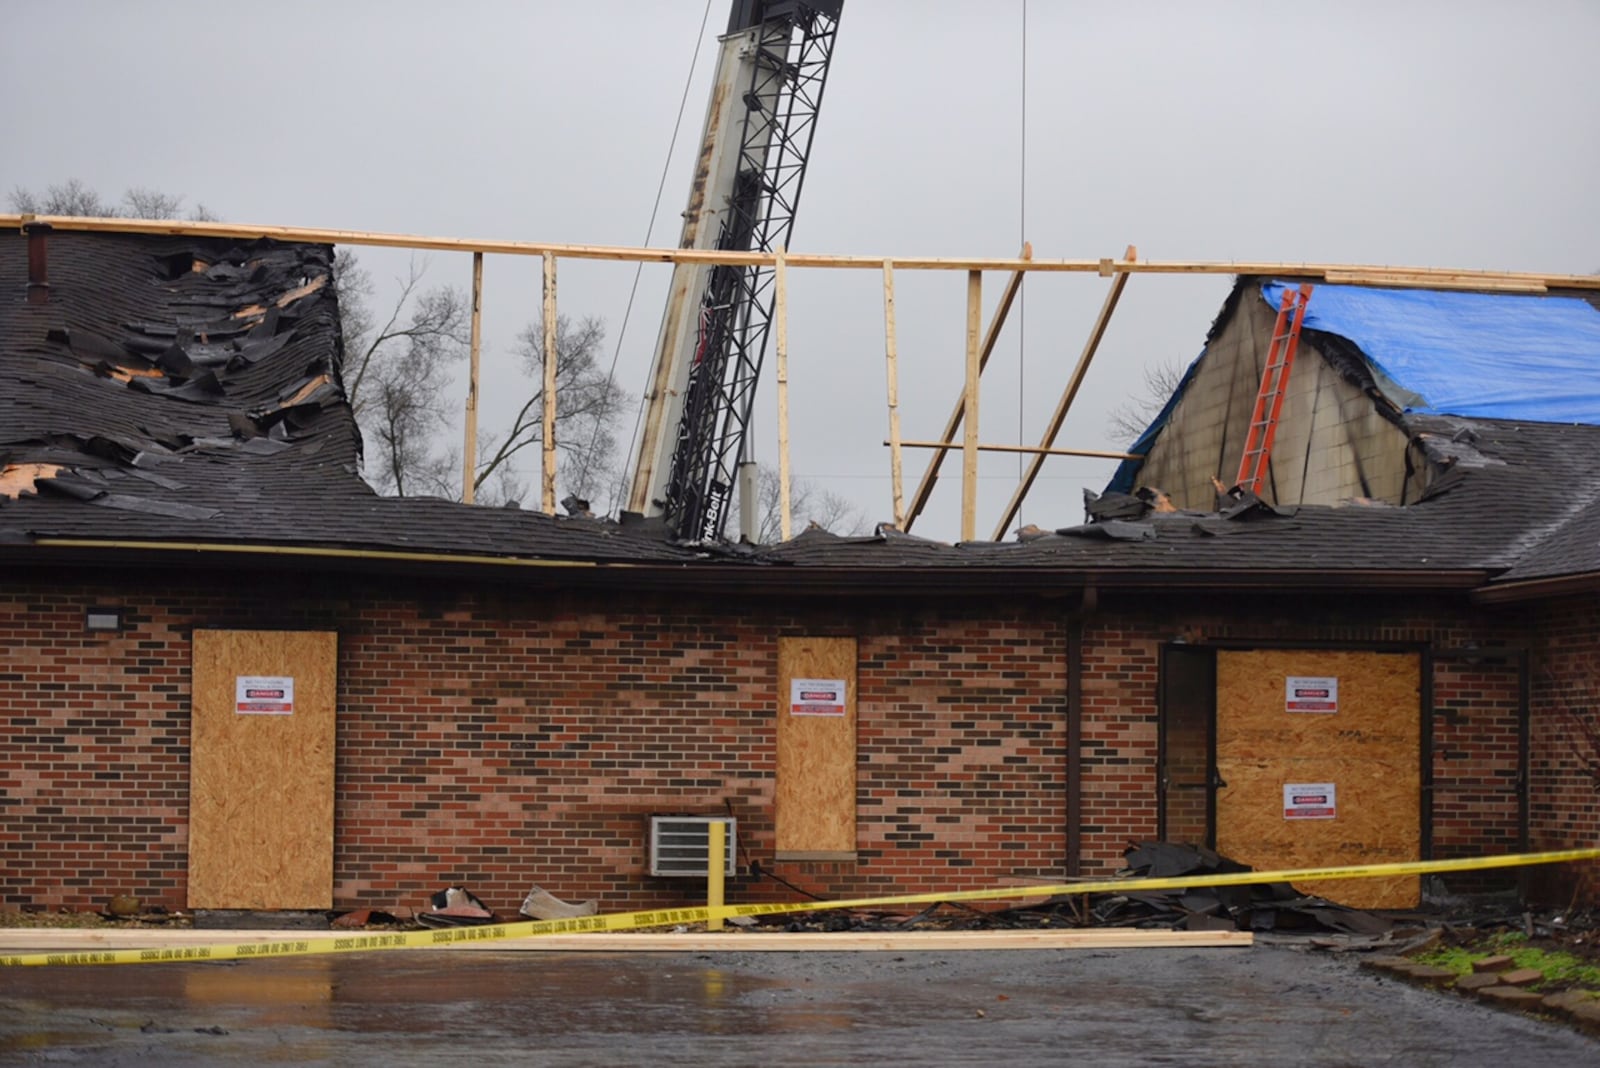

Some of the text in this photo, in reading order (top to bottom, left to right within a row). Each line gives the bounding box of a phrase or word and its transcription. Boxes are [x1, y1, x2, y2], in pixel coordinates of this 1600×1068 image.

[533, 918, 606, 934] FIRE LINE DO NOT CROSS
[432, 928, 505, 943] FIRE LINE DO NOT CROSS
[236, 942, 308, 955] FIRE LINE DO NOT CROSS
[334, 936, 406, 949] FIRE LINE DO NOT CROSS
[140, 948, 211, 960] FIRE LINE DO NOT CROSS
